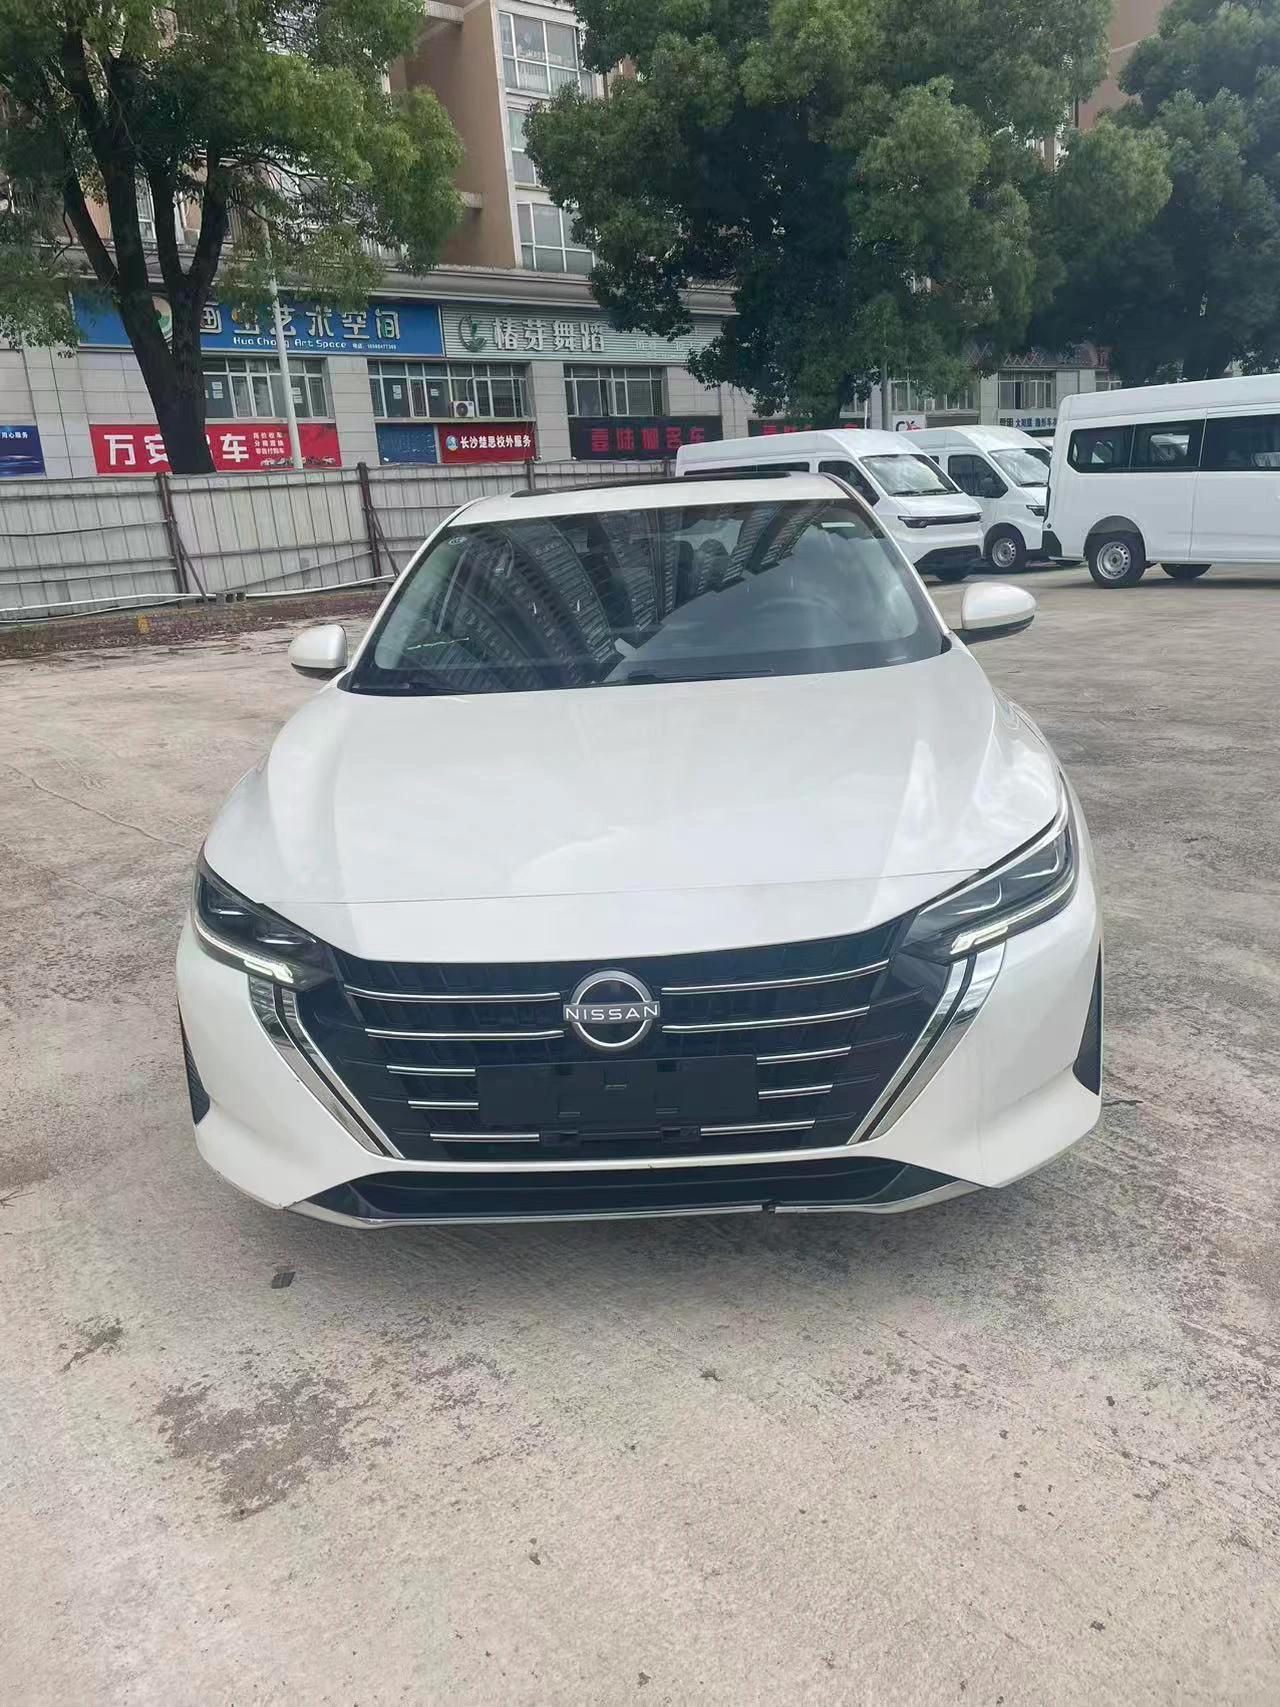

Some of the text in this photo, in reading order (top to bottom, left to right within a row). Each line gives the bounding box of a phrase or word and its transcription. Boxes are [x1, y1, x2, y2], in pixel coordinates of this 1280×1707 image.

[257, 337, 290, 349] Chog
[294, 338, 314, 347] Art
[316, 339, 347, 349] Space
[493, 317, 605, 352] 椿芽舞蹈
[104, 434, 250, 466] 万安车
[565, 1004, 659, 1021] NISSAN
